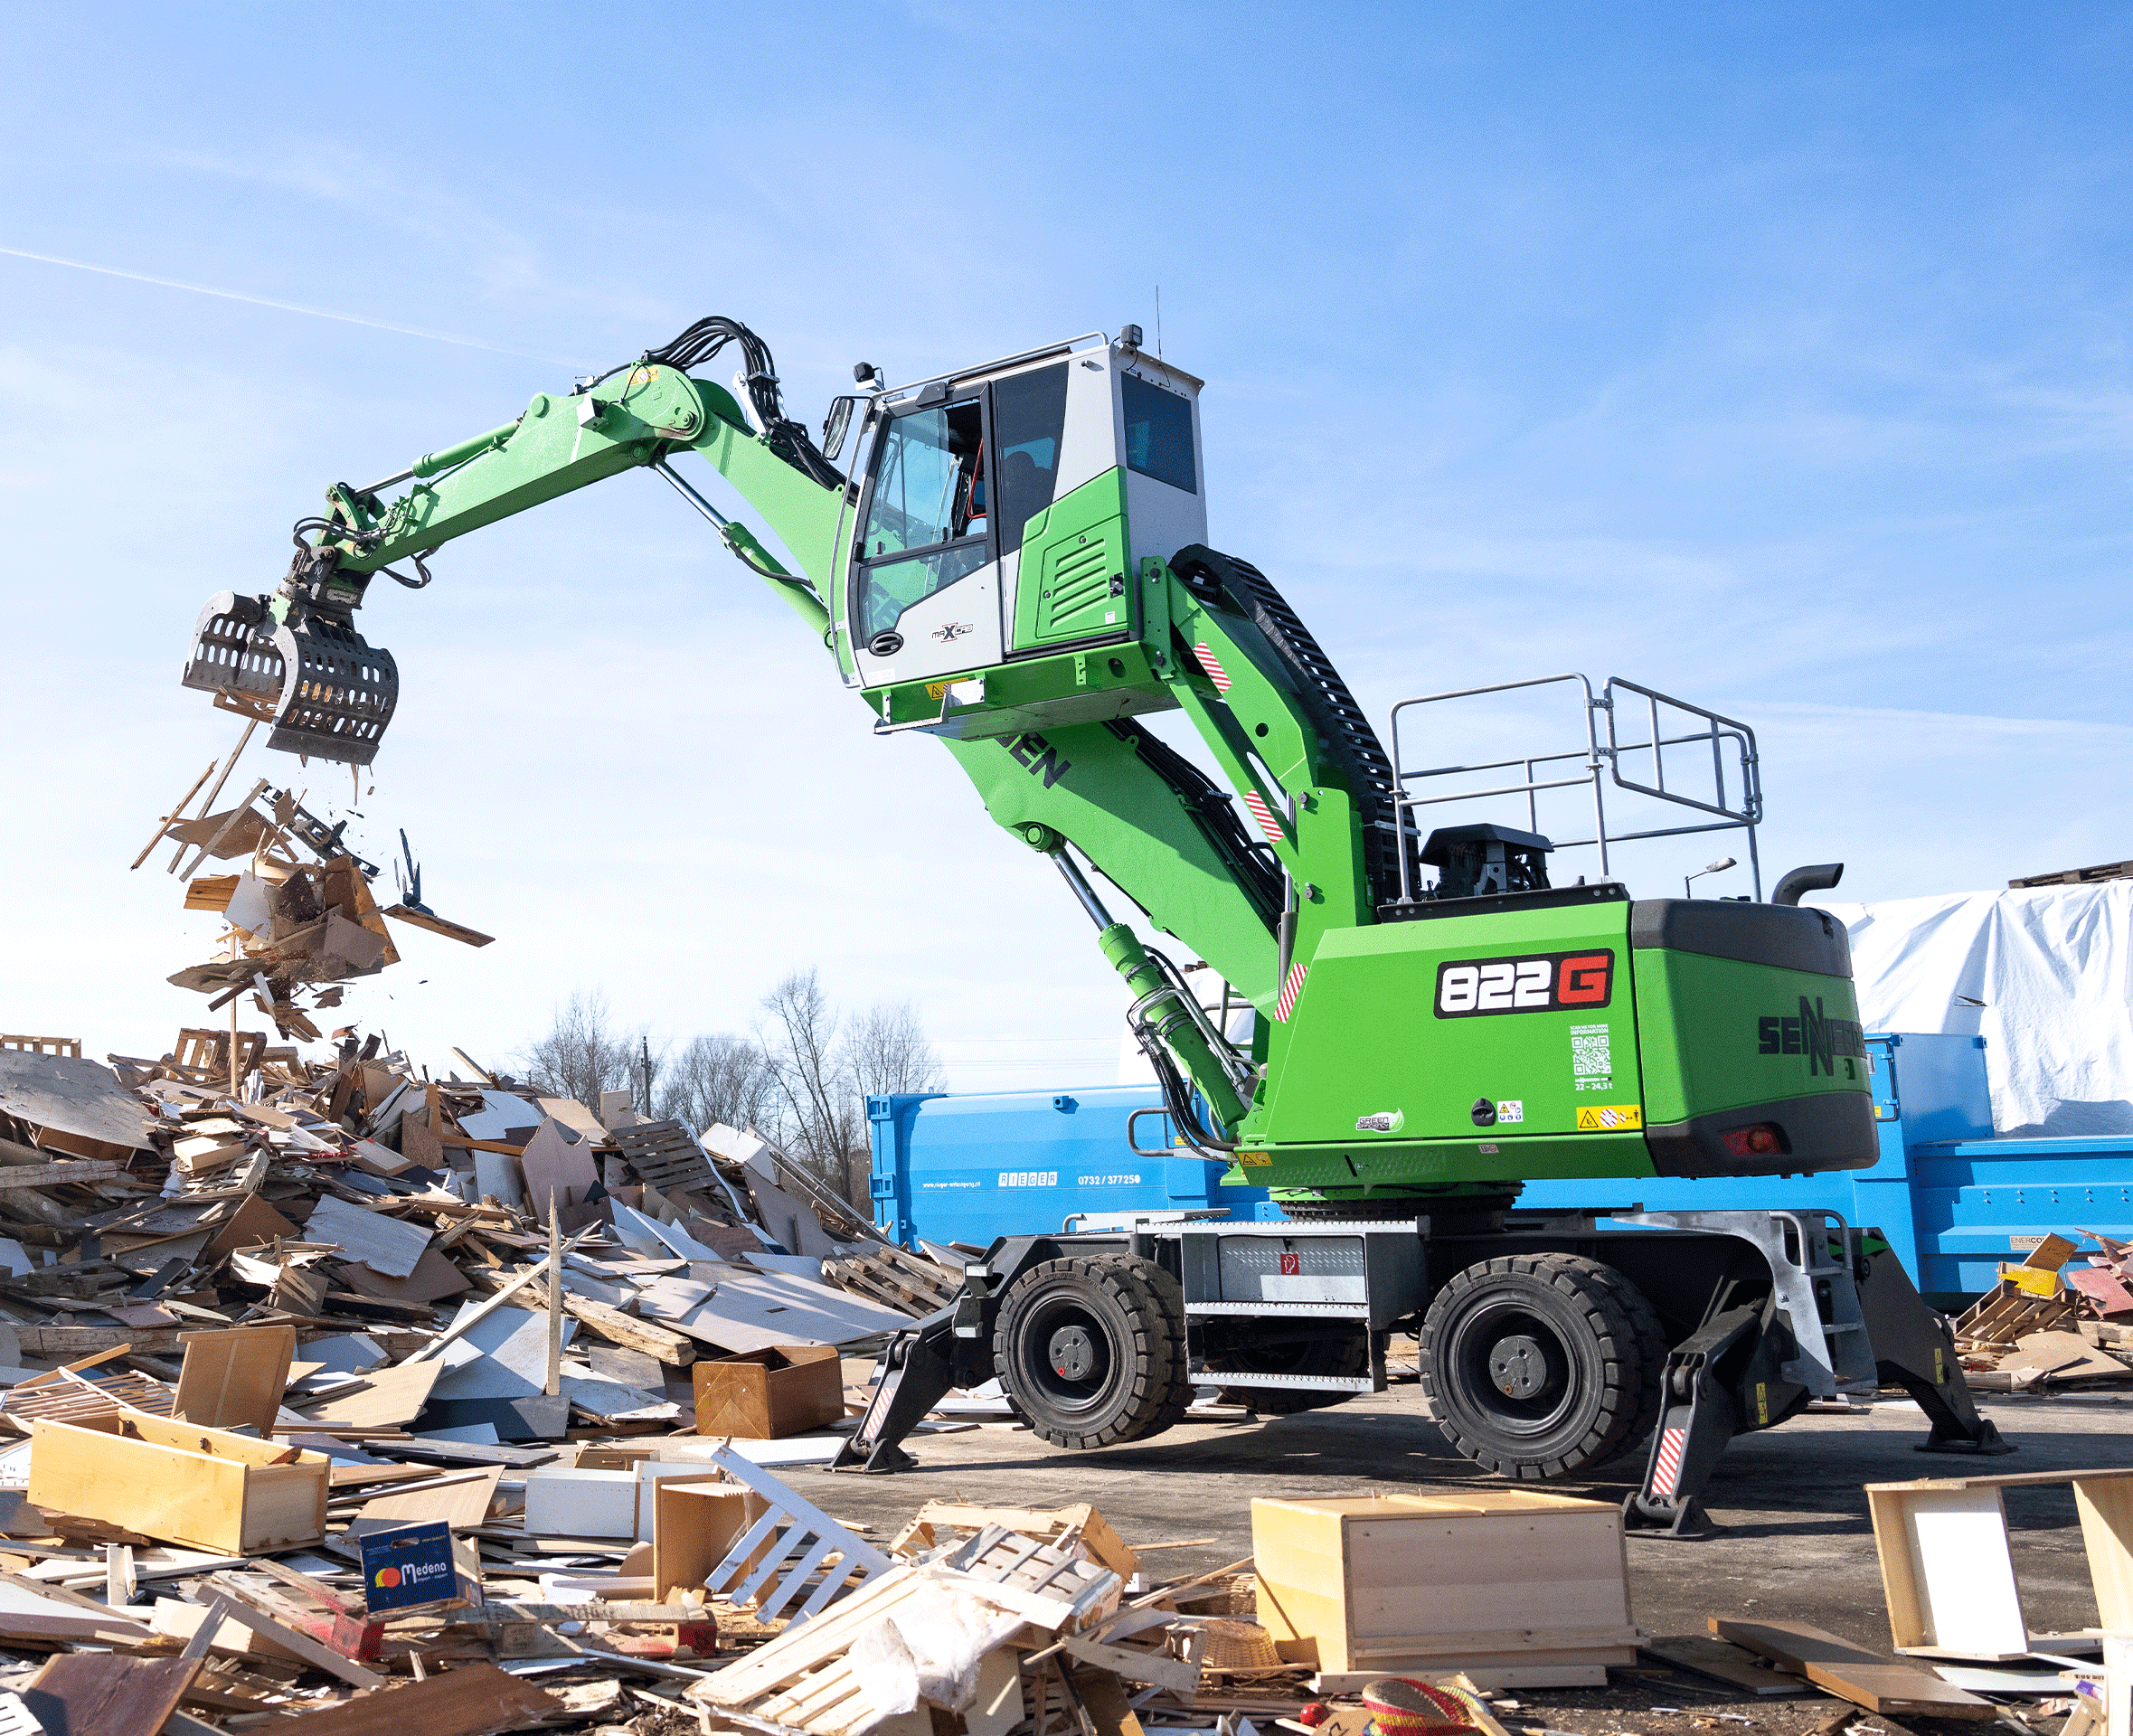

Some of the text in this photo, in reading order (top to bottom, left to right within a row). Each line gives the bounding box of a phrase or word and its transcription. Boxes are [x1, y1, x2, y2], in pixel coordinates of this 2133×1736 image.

[1591, 1082, 1608, 1090] 24,3
[1000, 1174, 1056, 1185] RIEGER
[1078, 1175, 1100, 1185] 0732
